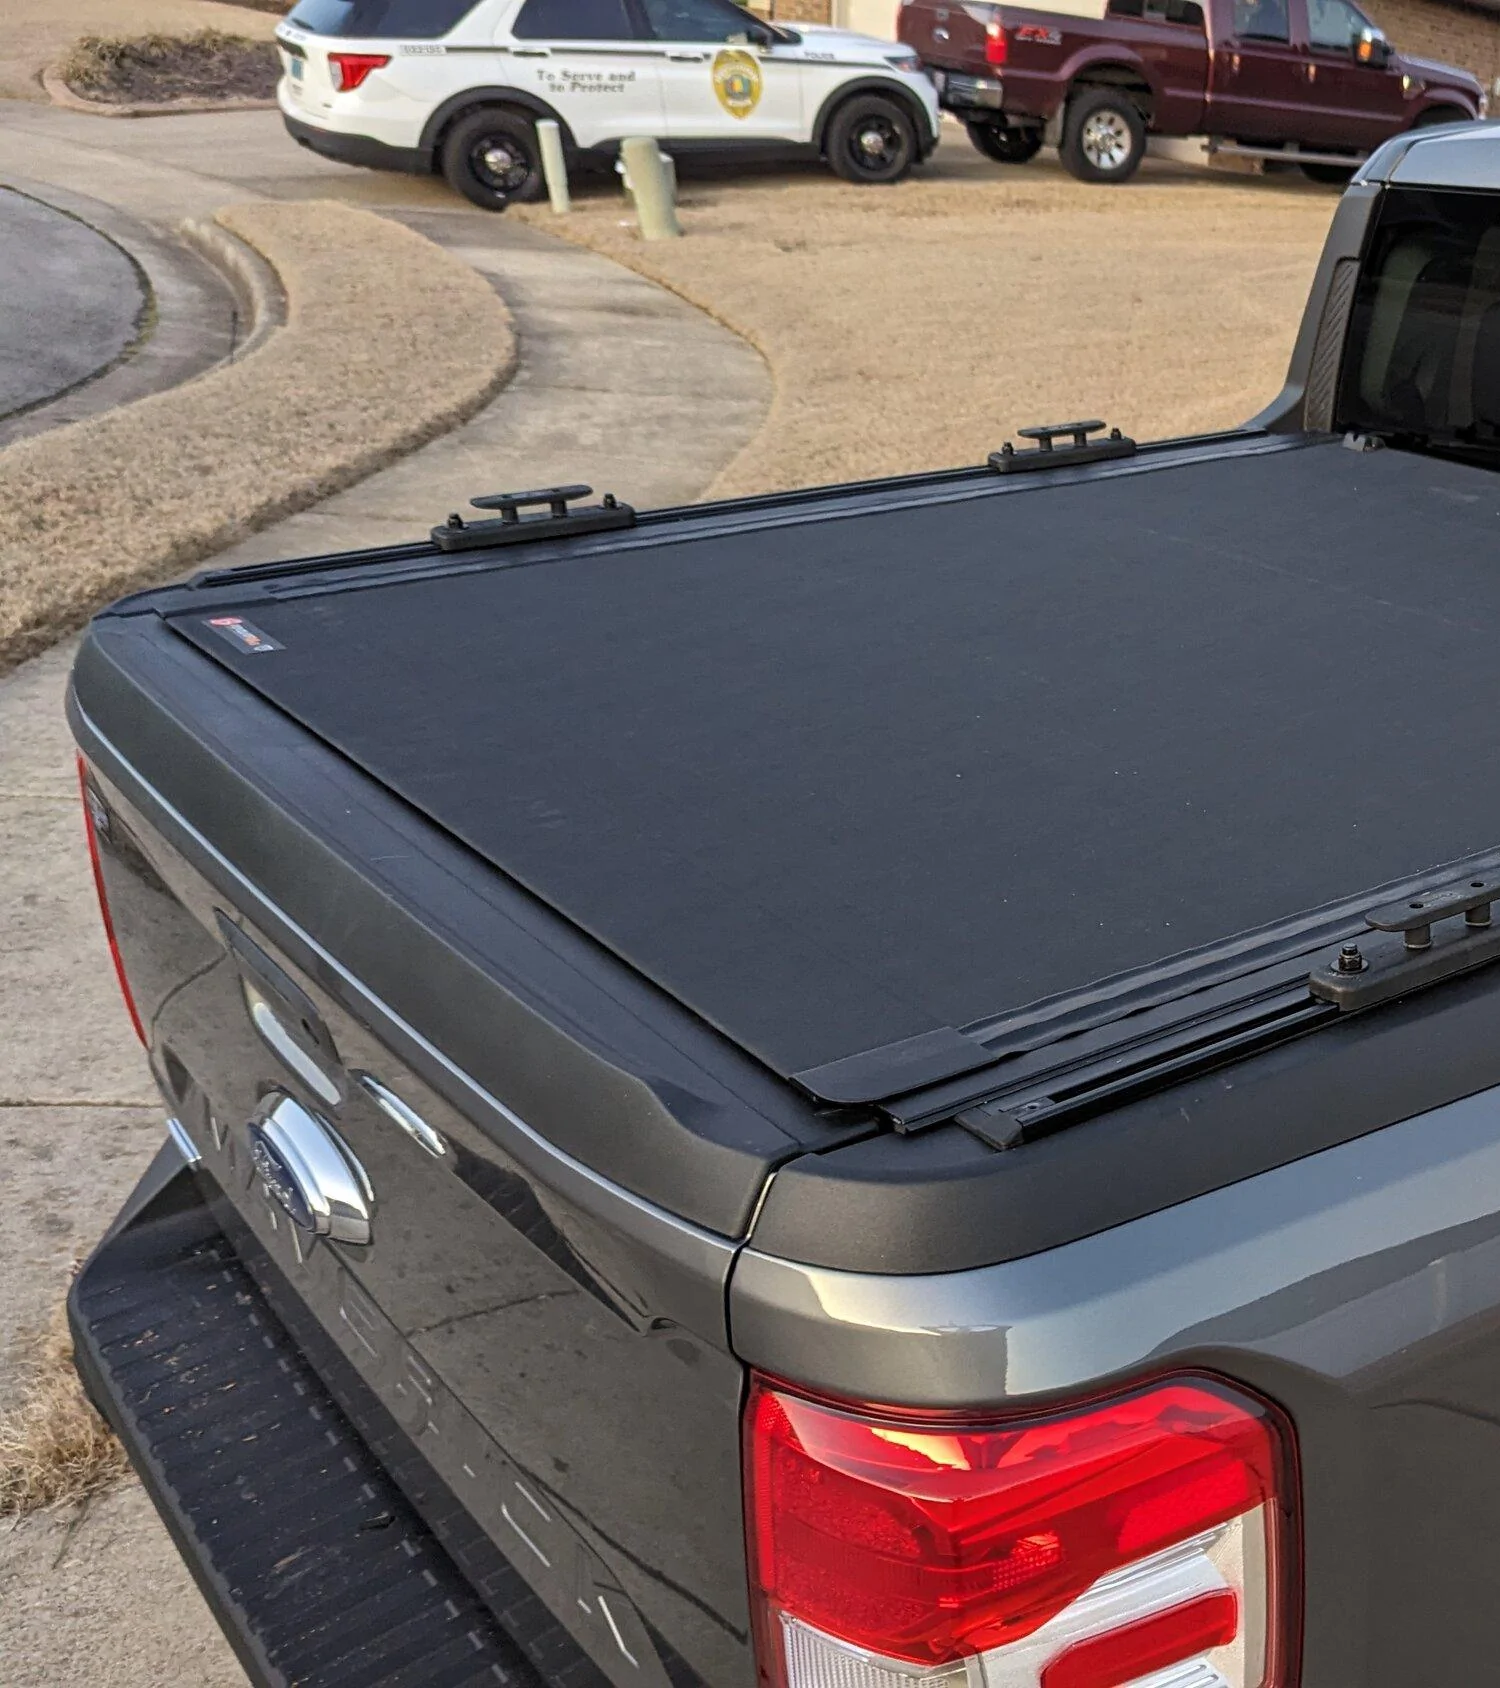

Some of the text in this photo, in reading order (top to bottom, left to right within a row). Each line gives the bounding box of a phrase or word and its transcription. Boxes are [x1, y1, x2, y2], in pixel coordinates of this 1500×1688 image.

[536, 68, 636, 82] To Serve and
[548, 81, 625, 93] to Protect
